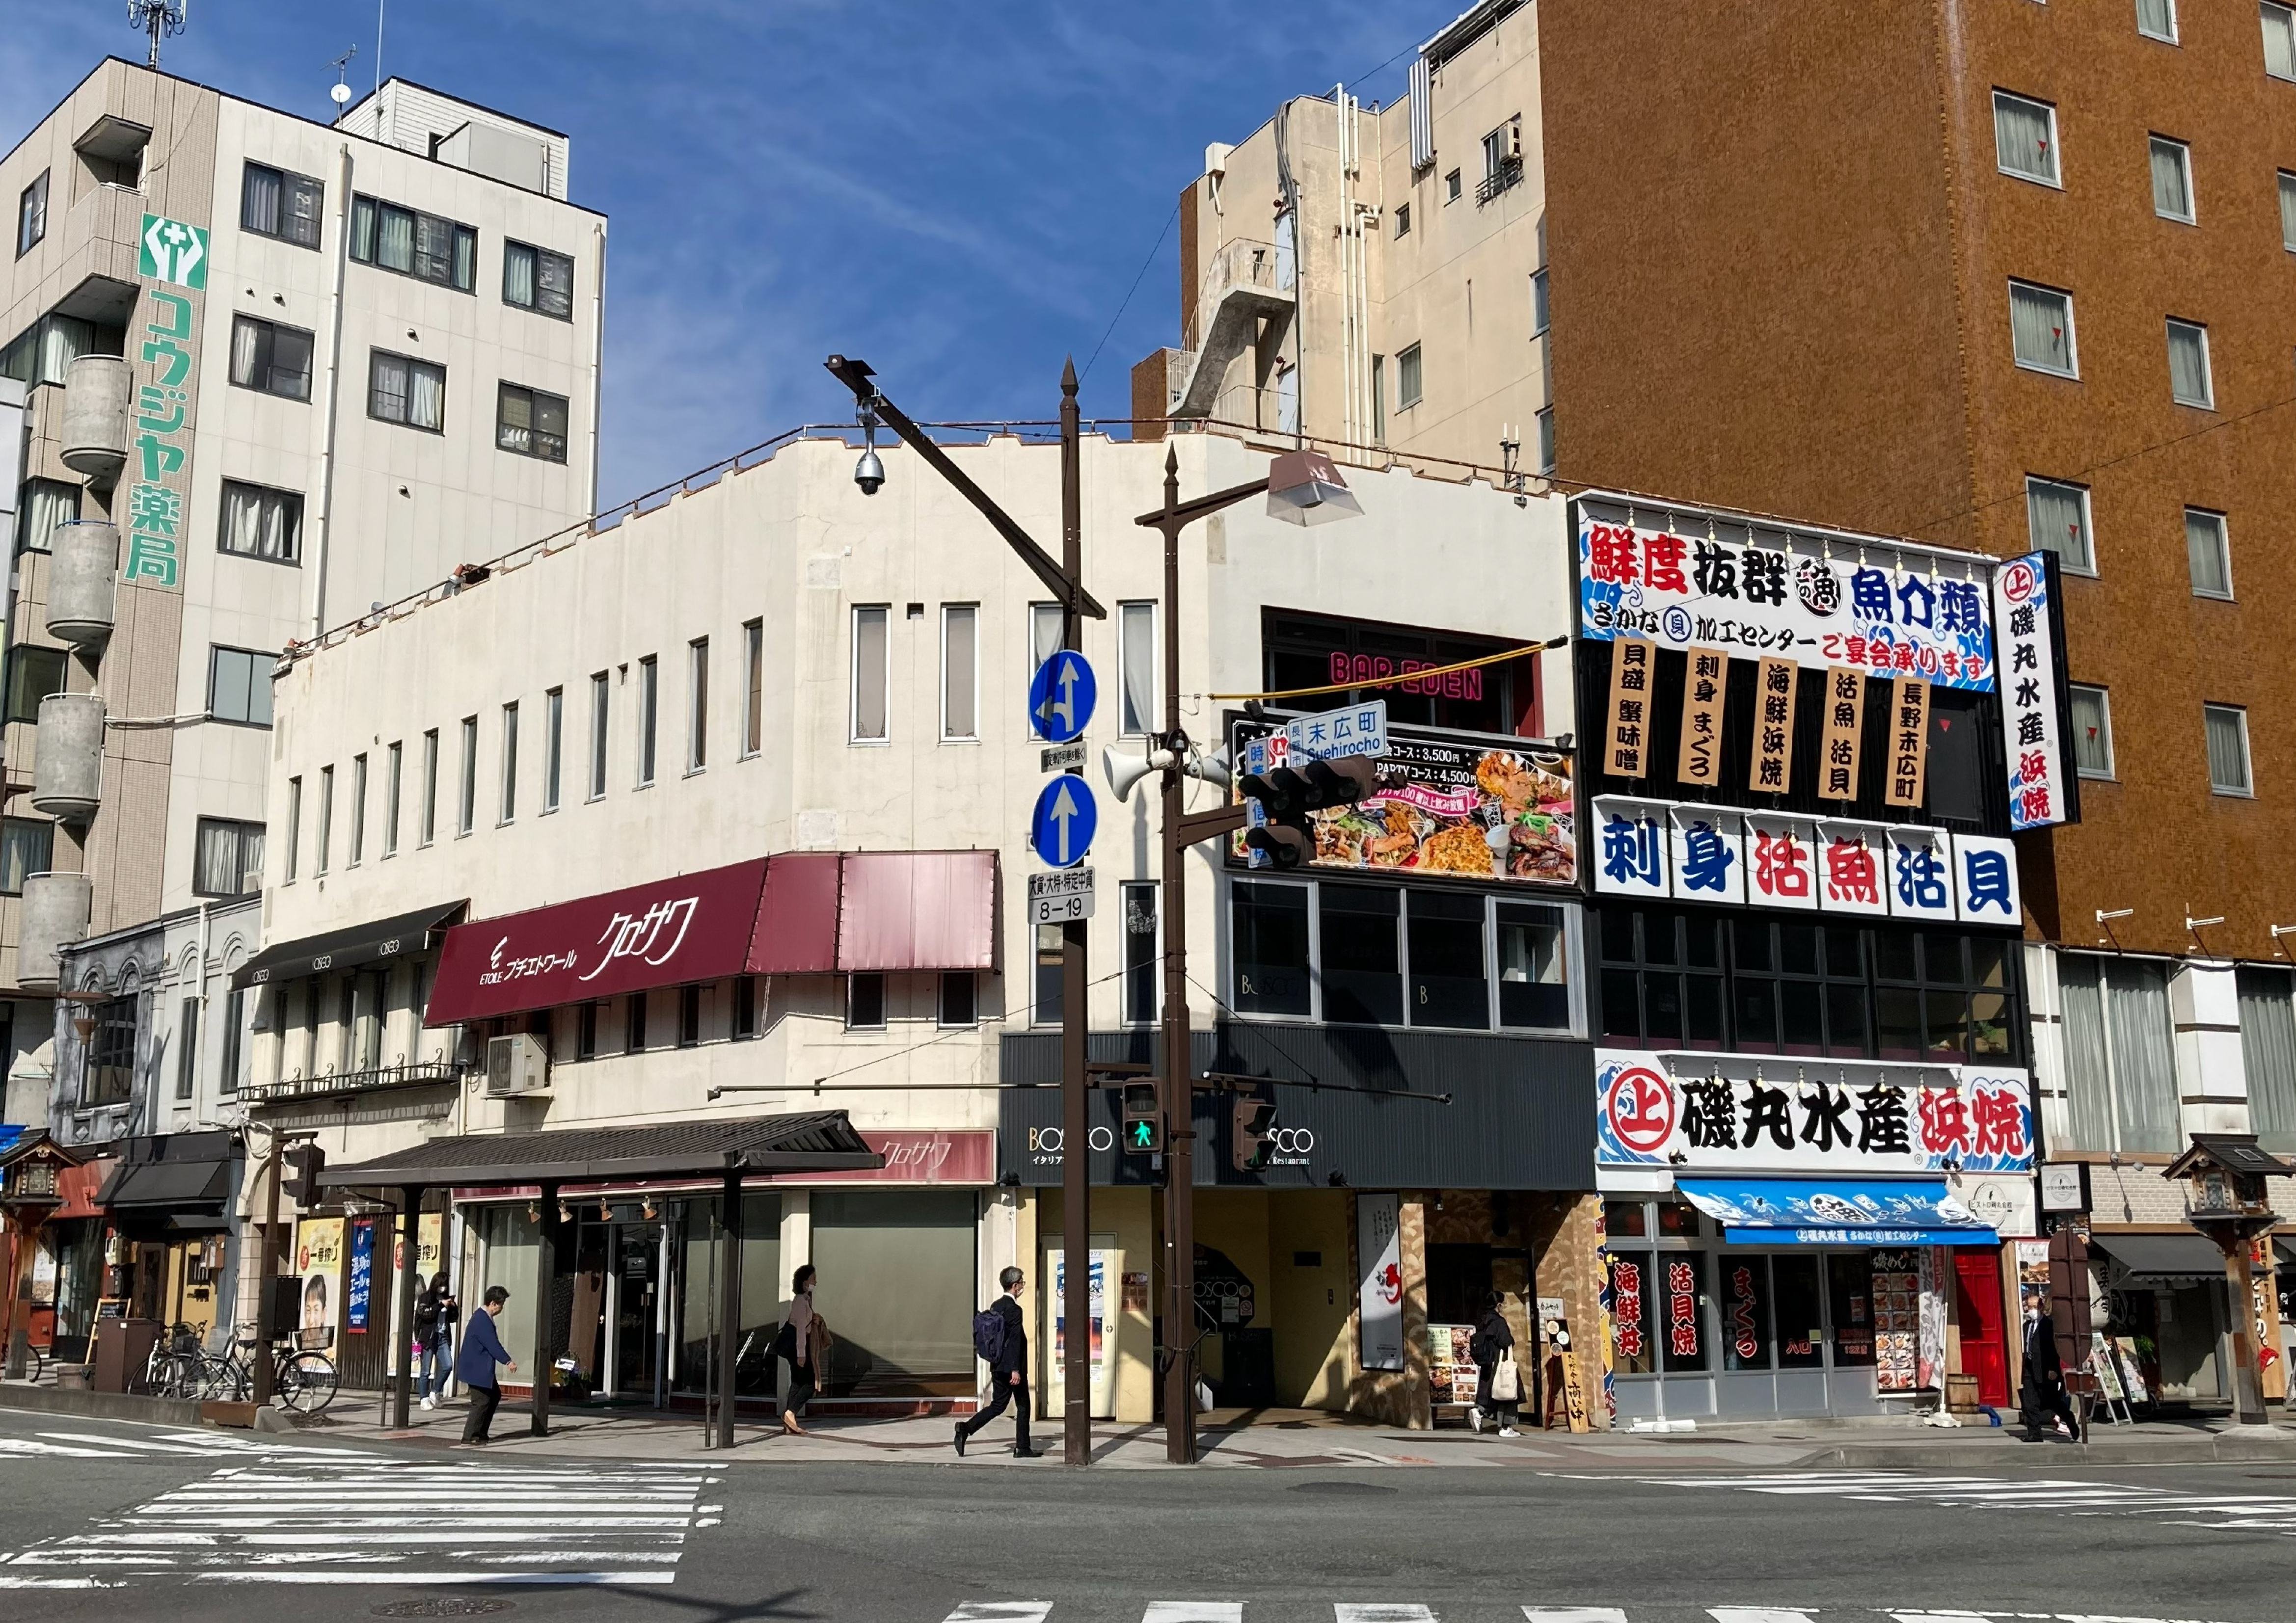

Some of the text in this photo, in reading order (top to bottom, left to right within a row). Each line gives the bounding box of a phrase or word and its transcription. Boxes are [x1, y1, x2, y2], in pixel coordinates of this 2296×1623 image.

[124, 289, 193, 587] コウジヤ薬局
[1591, 523, 1787, 607] 鮮度抜群
[1850, 566, 1984, 635] 魚介類
[1331, 652, 1393, 690] BAR
[1821, 633, 1984, 681] ご宴会承ります
[2009, 604, 2045, 746] 磯丸水産
[1308, 711, 1377, 745] 末広町
[1615, 643, 1646, 771] 貝盛 蟹味噌
[1689, 654, 1720, 778] 刺身 まぐろ
[1759, 664, 1791, 786] 海鮮浜焼
[1829, 672, 1858, 794] 活魚 活貝
[1895, 683, 1922, 800] 長野末広町
[1307, 737, 1380, 762] Suehirocho
[2020, 749, 2051, 821] 浜焼
[504, 949, 577, 981] プチエトワール
[1029, 1126, 1113, 1152] BOO
[1679, 1079, 1911, 1154] 磯丸水産
[1918, 1088, 2026, 1156] 浜焼
[1033, 1156, 1064, 1165] イタリア
[1193, 1281, 1239, 1298] OSCO
[1614, 1262, 1642, 1357] 海鮮丼
[1669, 1262, 1698, 1356] 活貝焼
[1733, 1266, 1758, 1358] まぐろ
[1785, 1338, 1812, 1356] 入口
